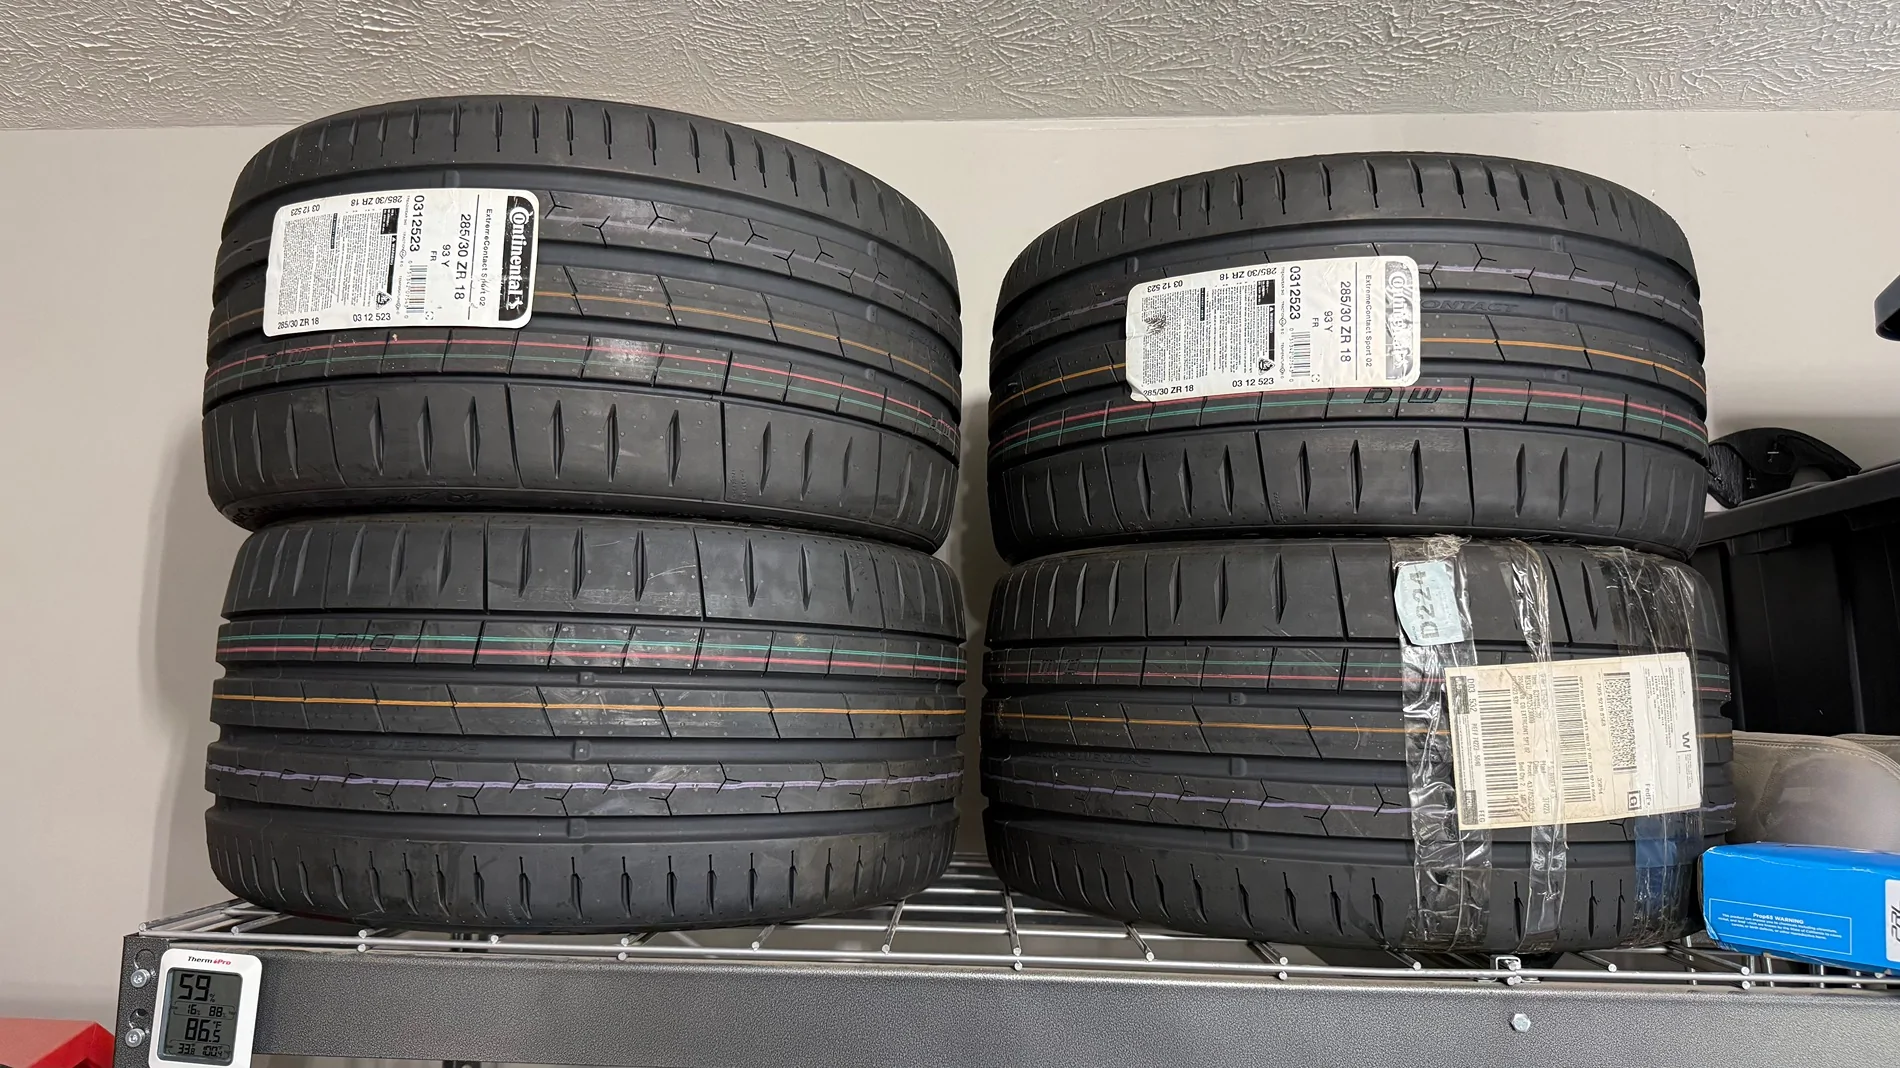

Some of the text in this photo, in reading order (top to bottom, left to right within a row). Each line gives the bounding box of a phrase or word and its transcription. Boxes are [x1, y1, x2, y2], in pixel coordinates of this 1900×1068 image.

[350, 199, 360, 207] 18
[375, 196, 403, 205] 285/30
[290, 208, 302, 216] 523
[311, 204, 321, 212] 03
[410, 195, 426, 253] 0312523
[481, 208, 493, 271] ExtremeContact
[430, 250, 438, 262] FR
[441, 244, 452, 268] 93 Y
[454, 213, 471, 300] 285/30 ZR 18
[508, 207, 534, 296] Continental
[1220, 268, 1277, 281] 285/30 ZR 18
[1147, 280, 1184, 293] 03 12 523
[1290, 266, 1301, 320] 0312523
[479, 296, 487, 307] 02
[1420, 298, 1519, 313] ONTACT
[277, 317, 320, 330] 285/30 ZR 18
[353, 312, 391, 322] 03 12 523
[1312, 317, 1319, 328] FR
[1324, 311, 1333, 333] 93 Y
[1340, 281, 1351, 362] 285/30 ZR 18
[1364, 275, 1373, 367] ExtremeContact Sport 02
[1232, 380, 1242, 388] 03
[1257, 377, 1274, 386] 523
[1143, 385, 1194, 397] 285/30 ZR 18
[1682, 732, 1691, 748] W
[1630, 796, 1638, 806] G
[1752, 912, 1804, 925] Prop65 WARNING
